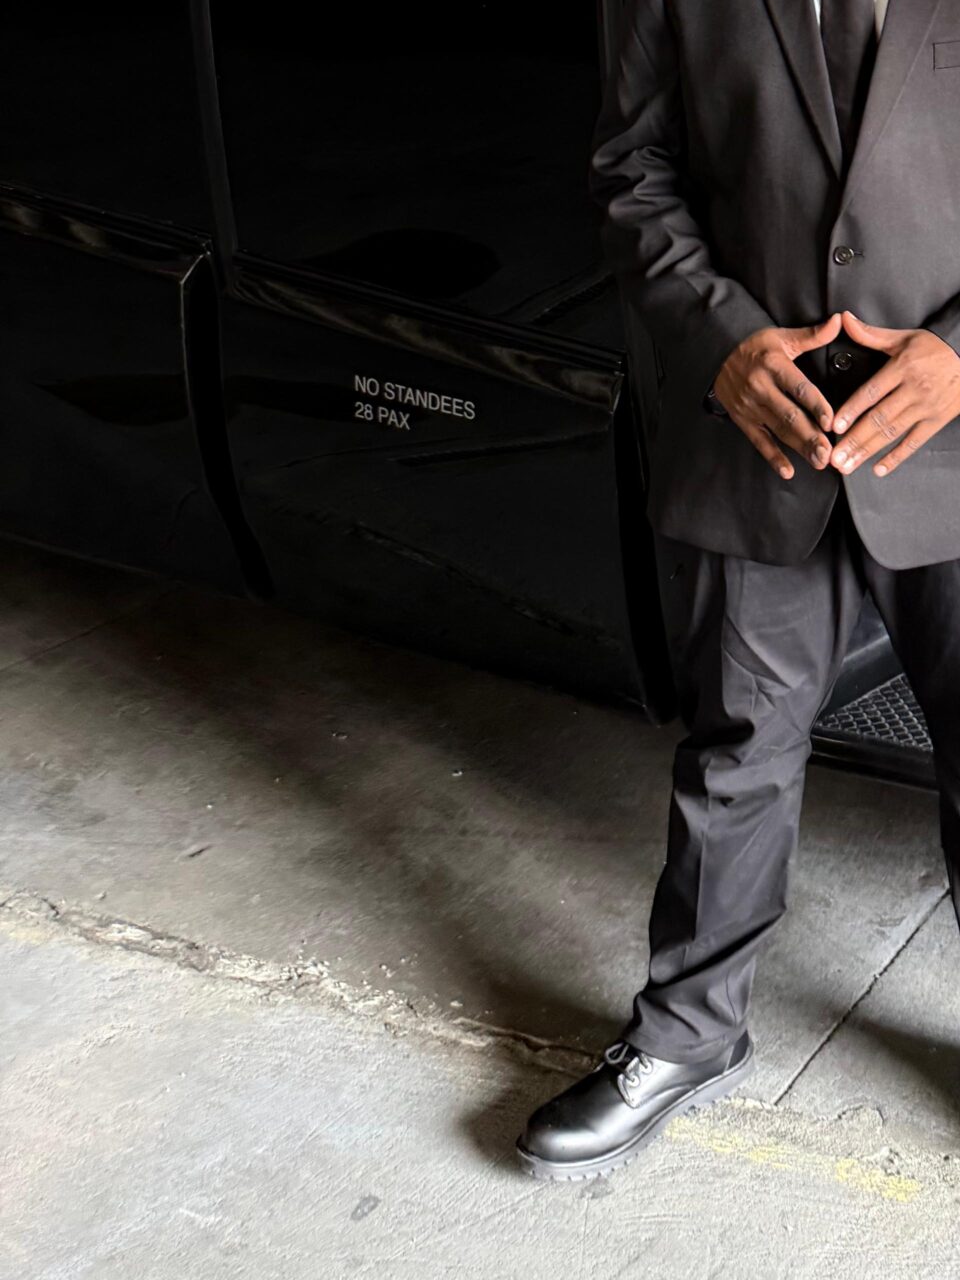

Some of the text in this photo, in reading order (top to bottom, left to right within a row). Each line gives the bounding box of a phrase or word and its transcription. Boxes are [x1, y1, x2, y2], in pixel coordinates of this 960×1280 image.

[354, 374, 476, 420] NO STANDEES
[354, 401, 410, 430] 28 PAX
